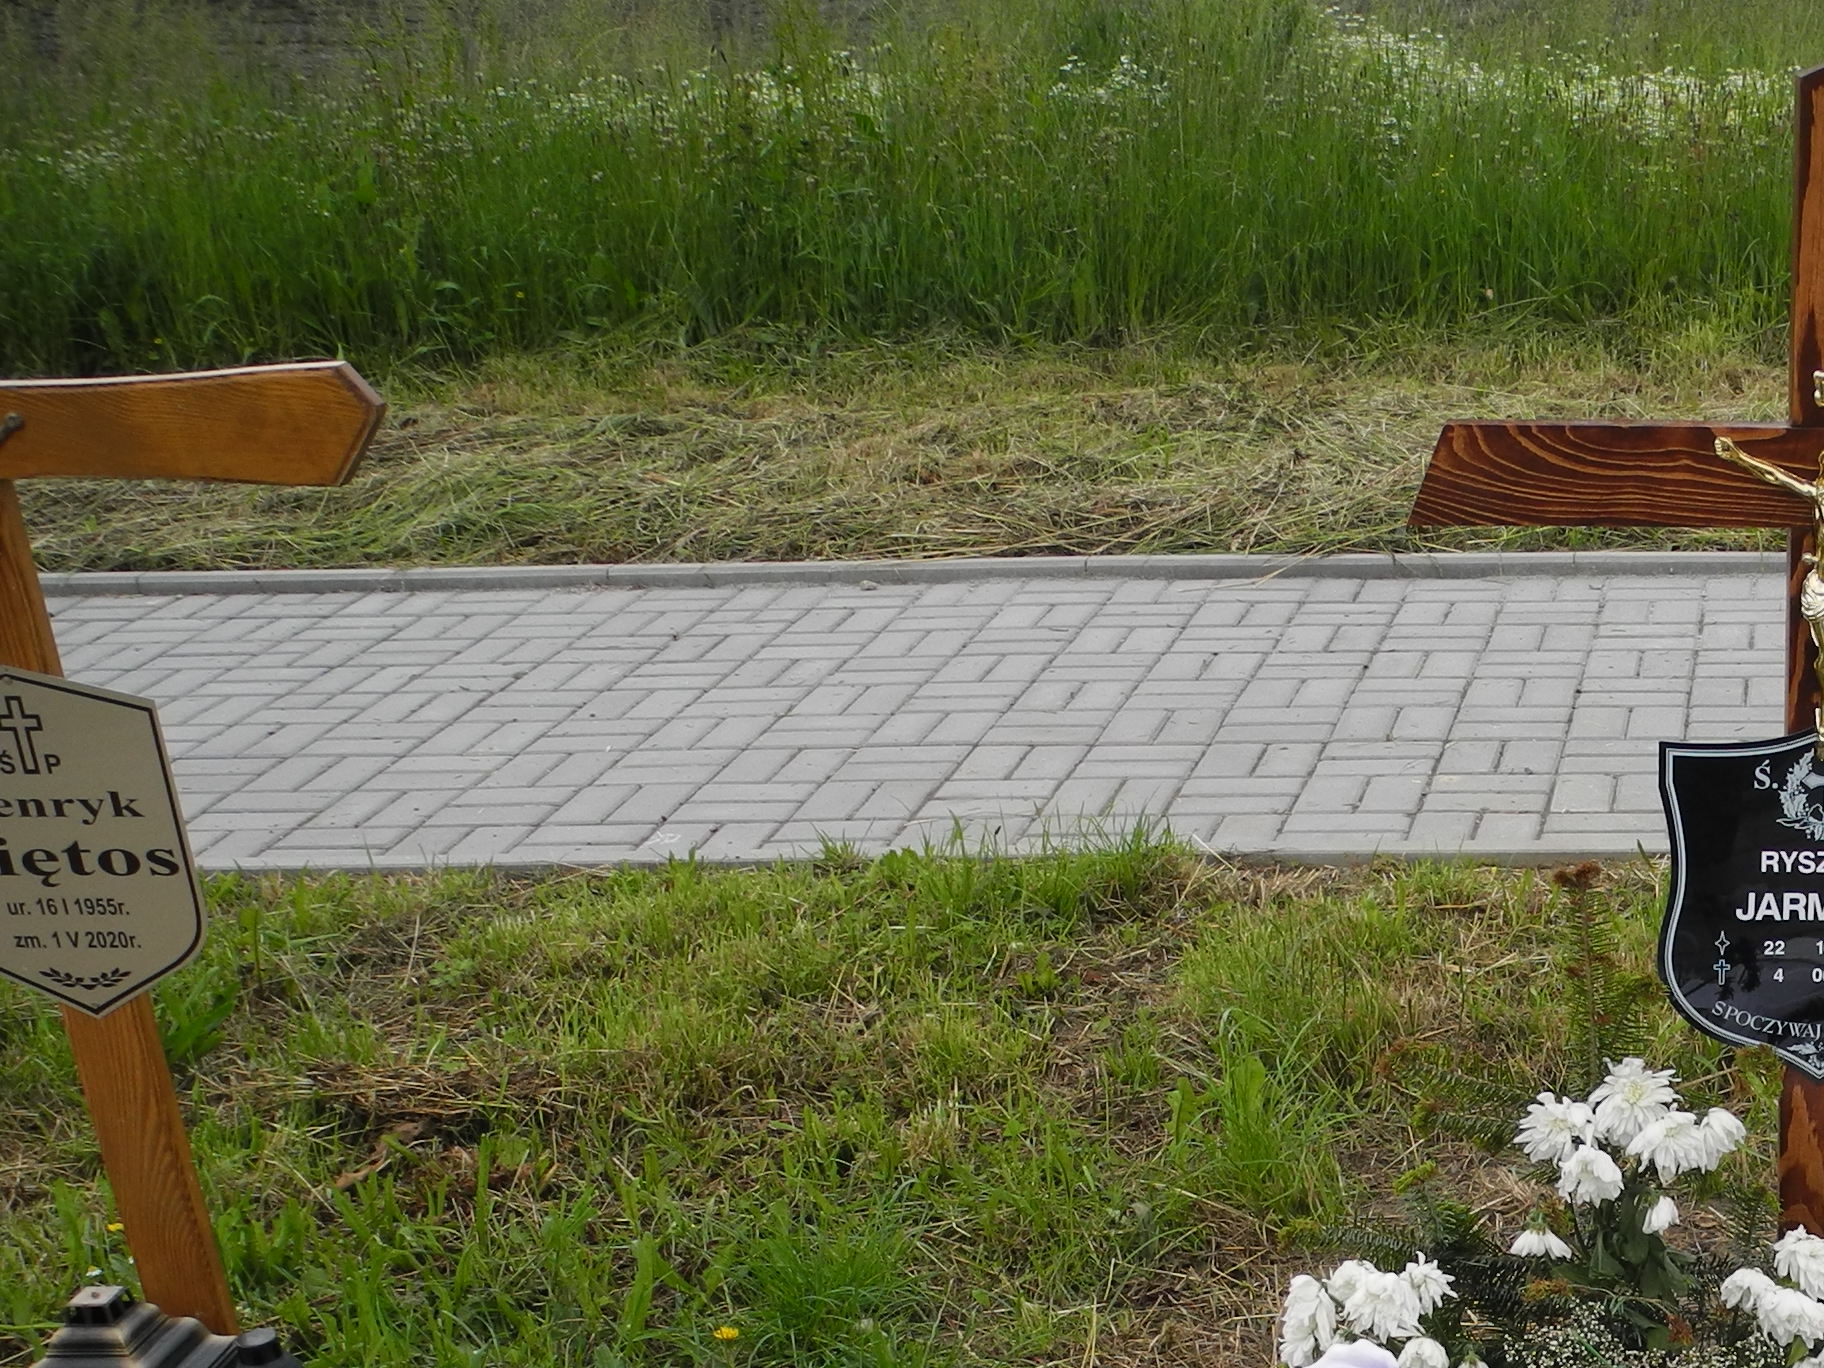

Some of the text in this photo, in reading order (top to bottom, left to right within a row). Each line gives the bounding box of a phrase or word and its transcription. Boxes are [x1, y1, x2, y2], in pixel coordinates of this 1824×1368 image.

[44, 754, 62, 775] P
[1753, 759, 1779, 791] Ś.
[6, 901, 32, 916] ur.
[36, 897, 58, 916] 16
[74, 897, 130, 916] 1955r.
[13, 930, 143, 949] zm. 1 V 2020r.
[1763, 940, 1786, 957] 22
[1773, 968, 1785, 983] 4
[1711, 1000, 1822, 1039] SPOCZYWAJ
